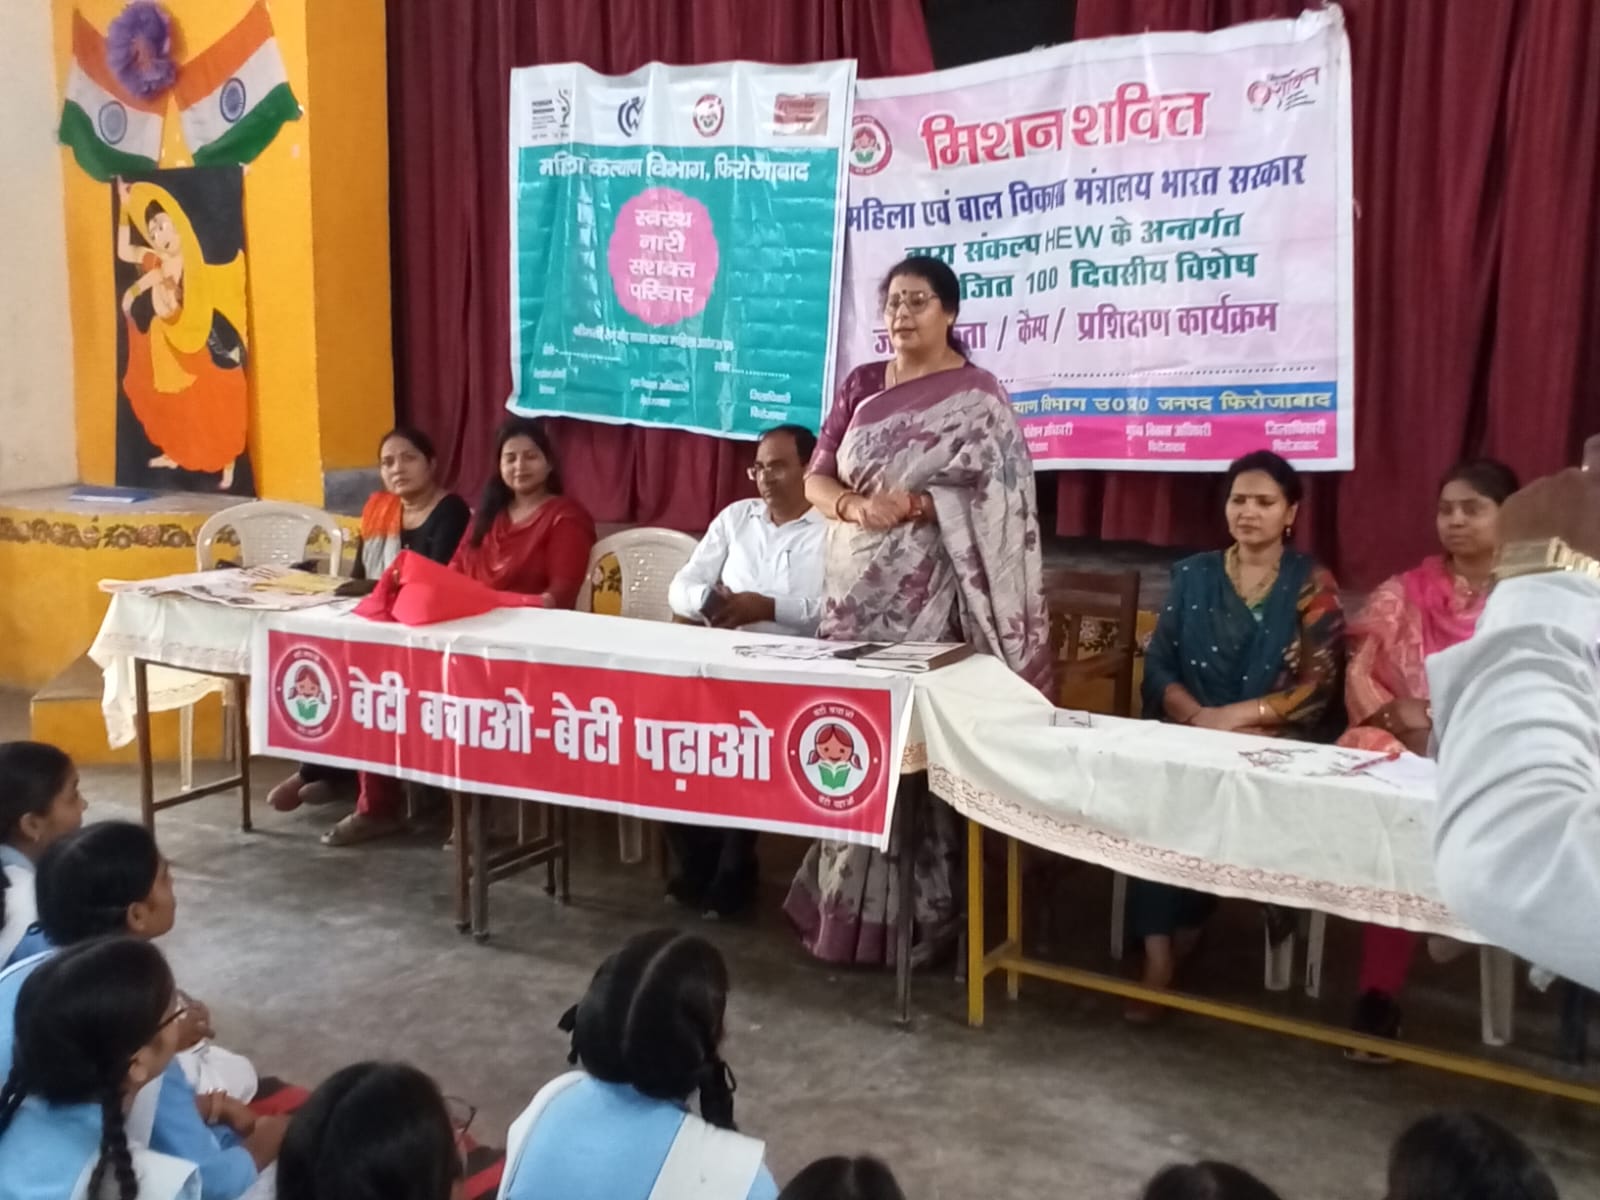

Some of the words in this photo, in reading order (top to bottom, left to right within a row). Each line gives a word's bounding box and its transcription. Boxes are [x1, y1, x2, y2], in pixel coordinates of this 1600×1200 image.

[920, 113, 1066, 171] मिशन
[1070, 82, 1211, 146] शक्ति
[848, 198, 916, 231] महिला
[922, 189, 951, 226] एवं
[955, 191, 1004, 221] बाल
[1074, 167, 1154, 205] मंत्रालय
[1161, 166, 1222, 198] भारत
[1229, 155, 1308, 194] सरकार
[639, 229, 687, 253] नारी
[963, 231, 1042, 263] संकल्प
[1045, 224, 1103, 253] HEW
[1110, 216, 1133, 246] के
[1141, 208, 1245, 244] अन्तर्गत
[630, 278, 696, 304] परिवार
[1026, 267, 1059, 294] 100
[1070, 255, 1169, 289] दिवसीय
[1176, 248, 1259, 283] विशेष
[1077, 303, 1172, 341] प्रशिक्षण
[1176, 294, 1280, 336] कार्यक्रम
[1041, 394, 1088, 412] विभाग
[1156, 396, 1214, 411] जनपद
[1219, 389, 1334, 410] फिरोजाबाद
[348, 665, 410, 736] बेटी
[634, 709, 775, 793] पढ़ाओ
